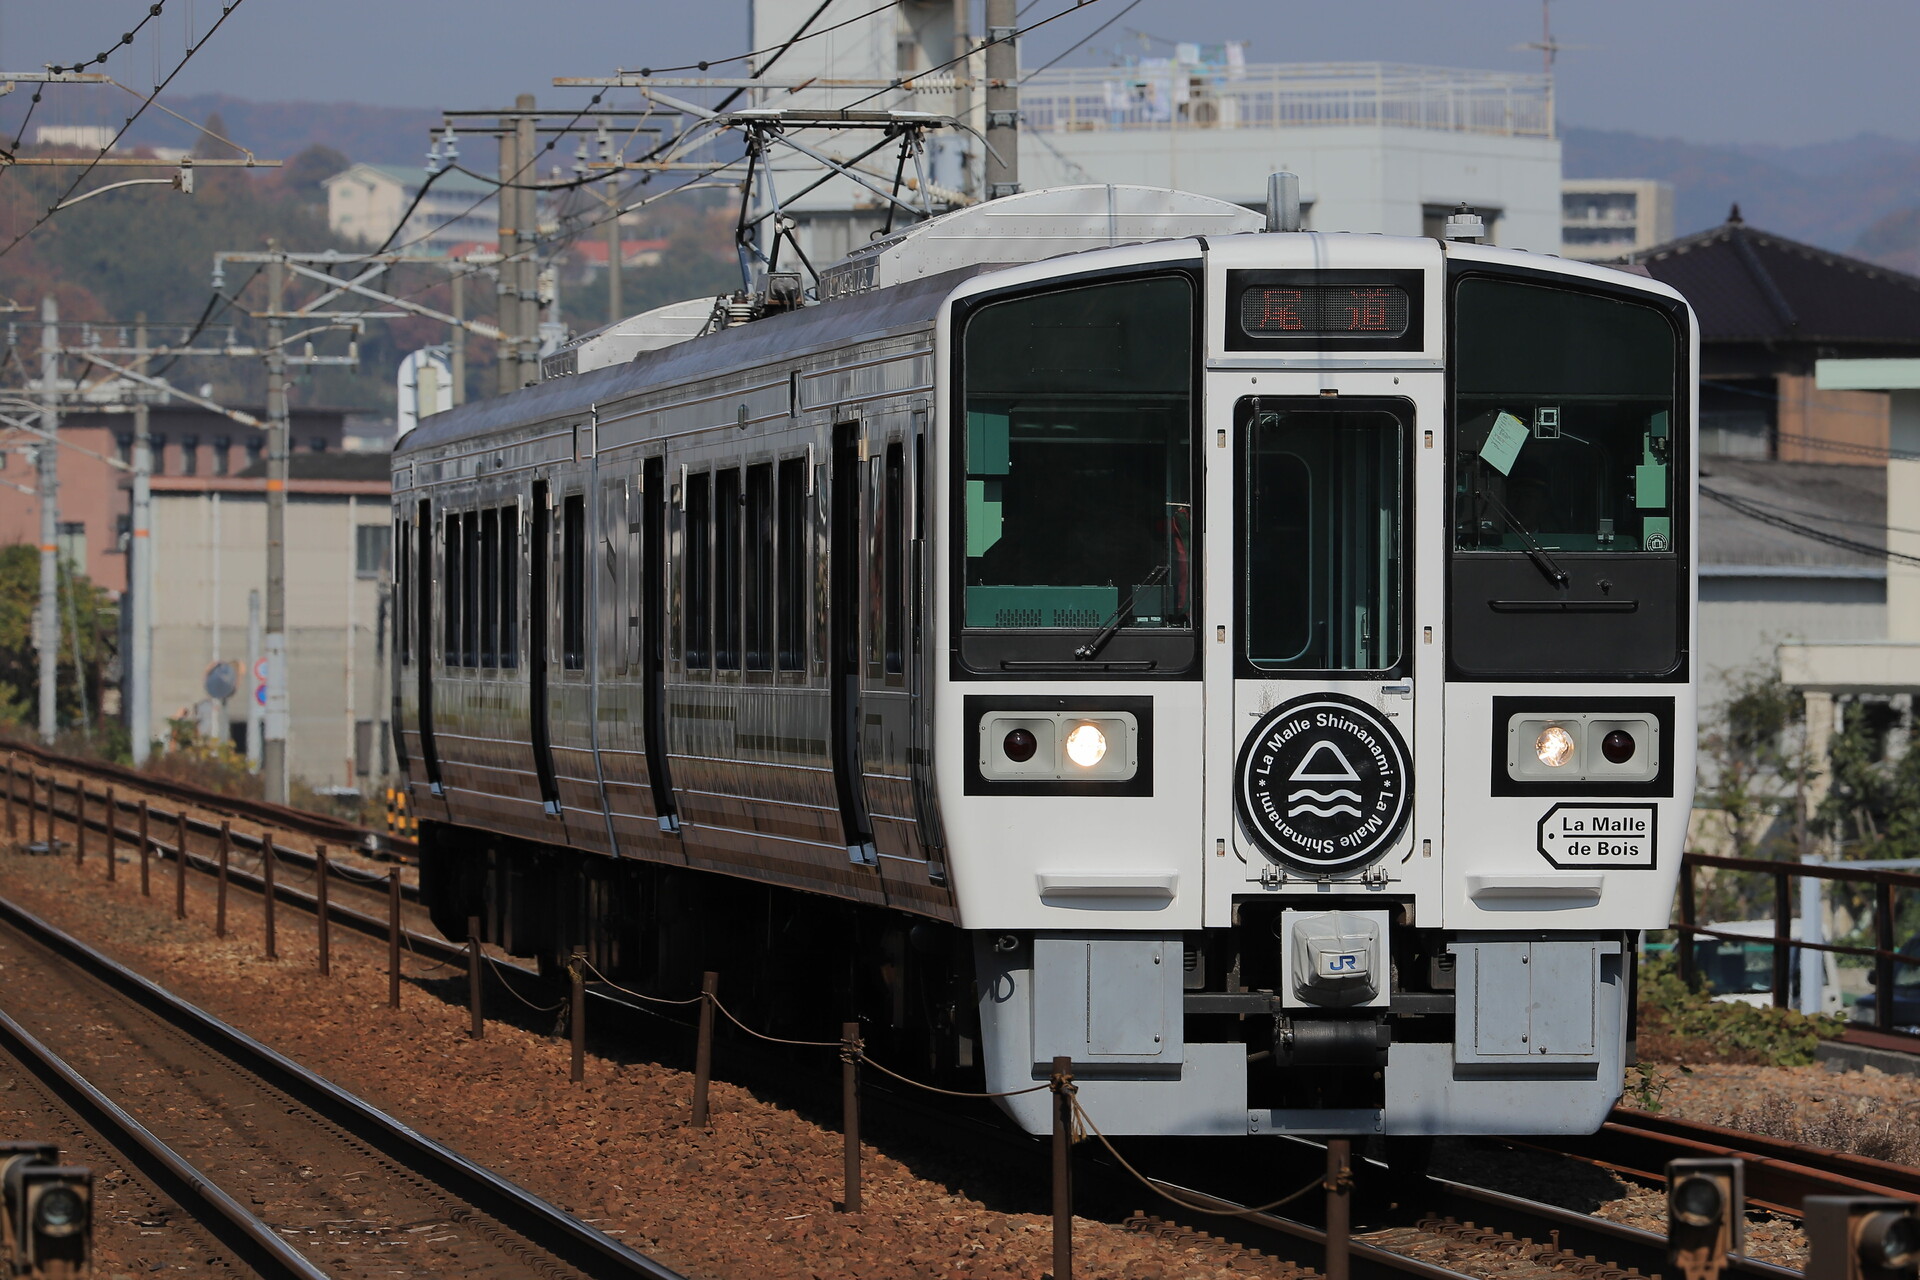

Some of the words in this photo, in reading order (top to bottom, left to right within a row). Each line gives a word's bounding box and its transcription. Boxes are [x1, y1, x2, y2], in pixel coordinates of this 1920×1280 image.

[1259, 288, 1390, 330] 尾道
[1256, 754, 1274, 775] La
[1266, 719, 1311, 753] Malle
[1316, 713, 1394, 776] Shimanami
[1375, 791, 1394, 812] La
[1256, 791, 1334, 854] Shimanami
[1340, 813, 1383, 847] Malle
[1562, 817, 1584, 831] La
[1592, 817, 1646, 831] Malle
[1567, 841, 1591, 856] de
[1597, 841, 1639, 856] Bois
[1329, 955, 1356, 971] JR
